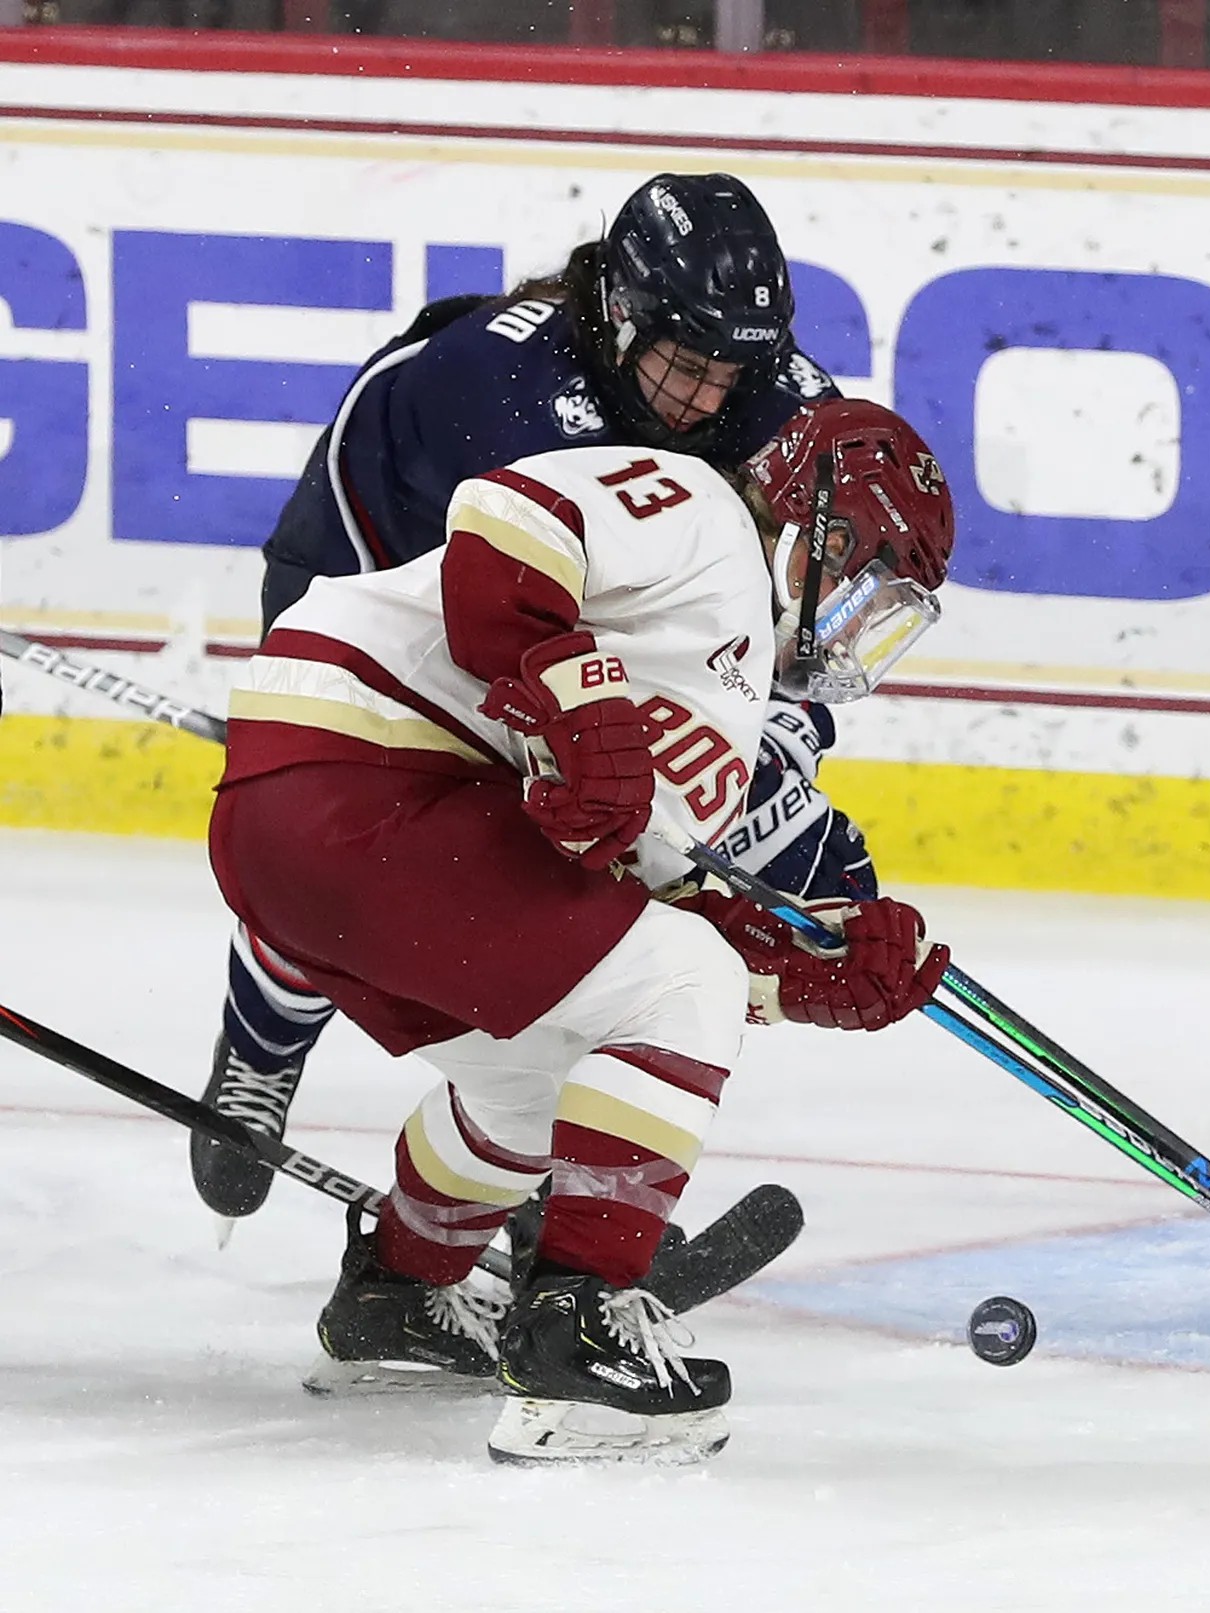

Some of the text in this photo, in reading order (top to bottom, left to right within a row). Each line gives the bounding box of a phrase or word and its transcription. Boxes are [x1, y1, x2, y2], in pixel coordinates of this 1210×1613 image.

[754, 286, 770, 308] 8
[732, 327, 780, 341] UCONN
[596, 458, 692, 520] 13
[581, 657, 630, 689] BA
[635, 694, 751, 849] BOS
